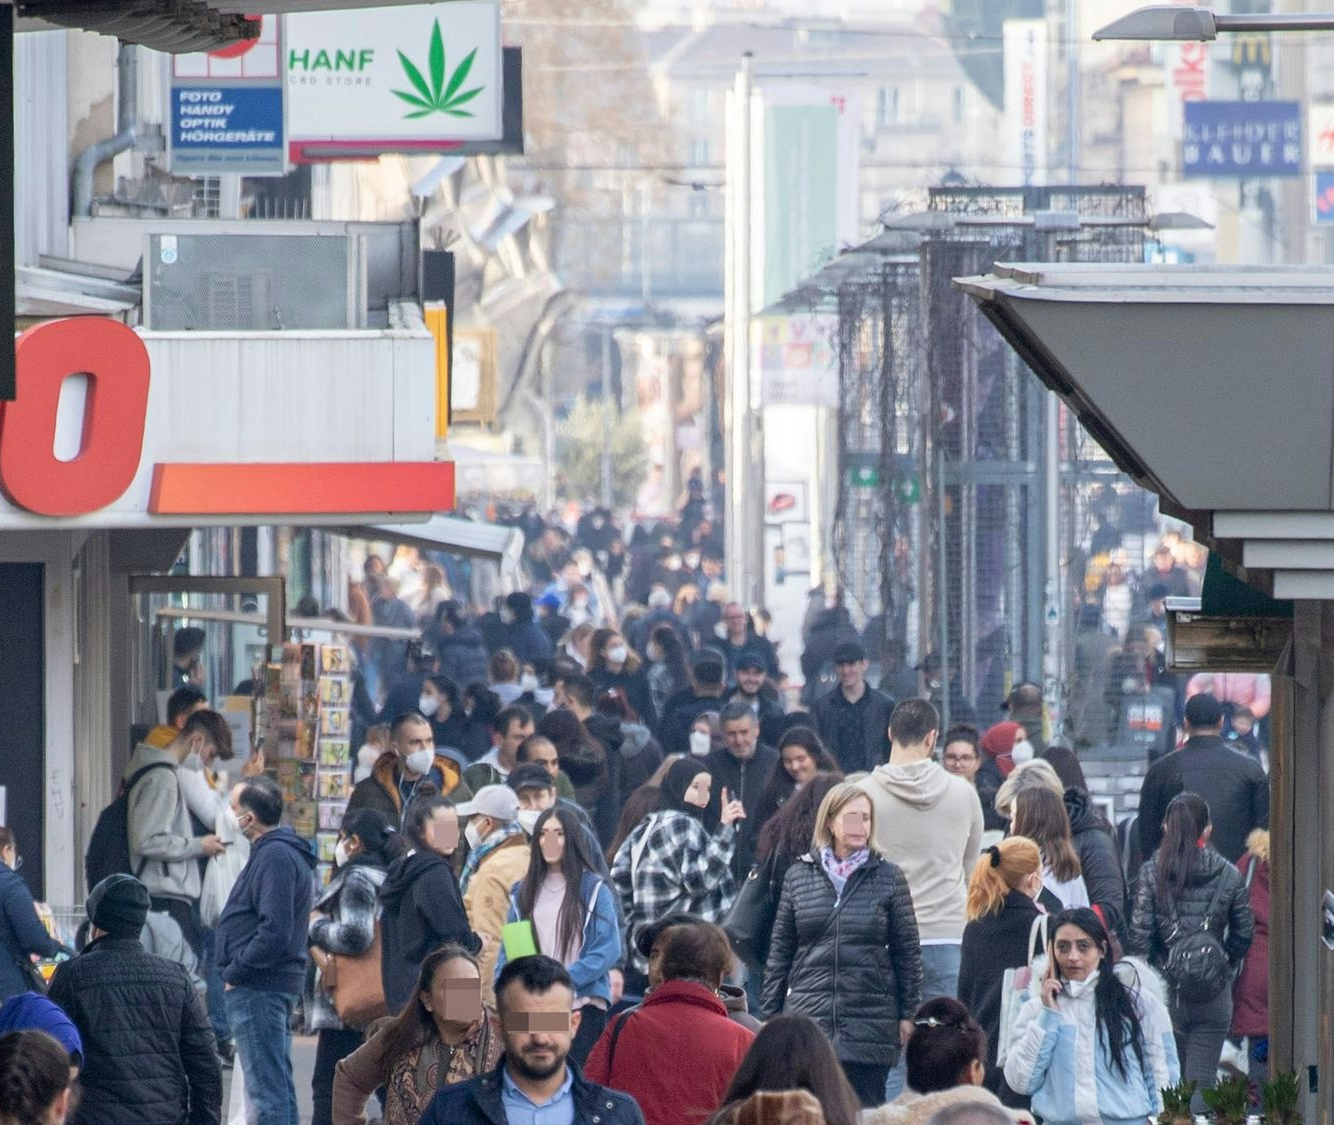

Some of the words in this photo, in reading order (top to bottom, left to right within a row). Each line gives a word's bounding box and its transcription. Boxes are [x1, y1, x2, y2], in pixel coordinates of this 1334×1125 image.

[288, 48, 375, 71] HANF
[289, 76, 316, 86] CBD
[325, 77, 372, 87] STORE
[179, 91, 223, 103] FOTO
[179, 104, 234, 116] HANDY
[179, 117, 227, 129] OPTIK
[179, 129, 275, 142] HÖRGERÄTE
[1184, 143, 1301, 165] BAUER
